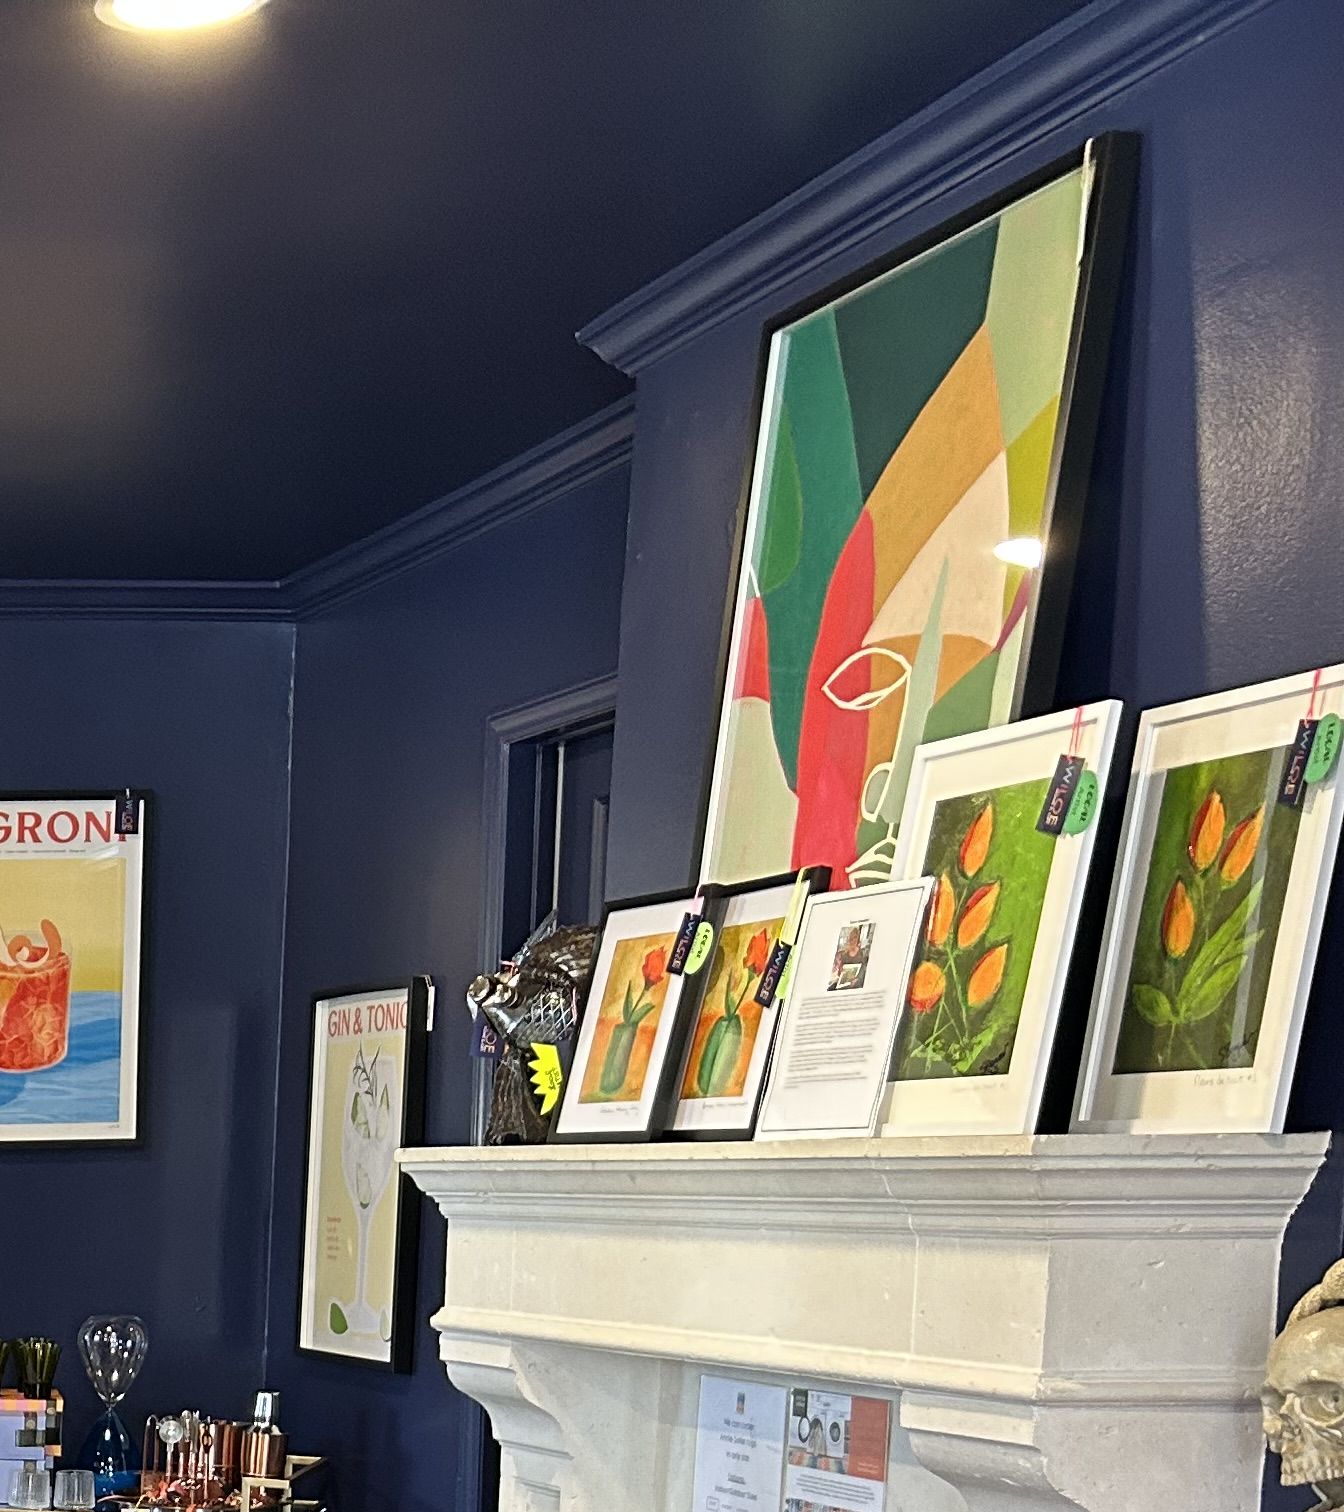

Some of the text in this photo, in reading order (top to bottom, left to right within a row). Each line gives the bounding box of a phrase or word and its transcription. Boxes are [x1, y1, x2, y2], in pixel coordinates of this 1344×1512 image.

[328, 1001, 408, 1037] GIN & TONIC
